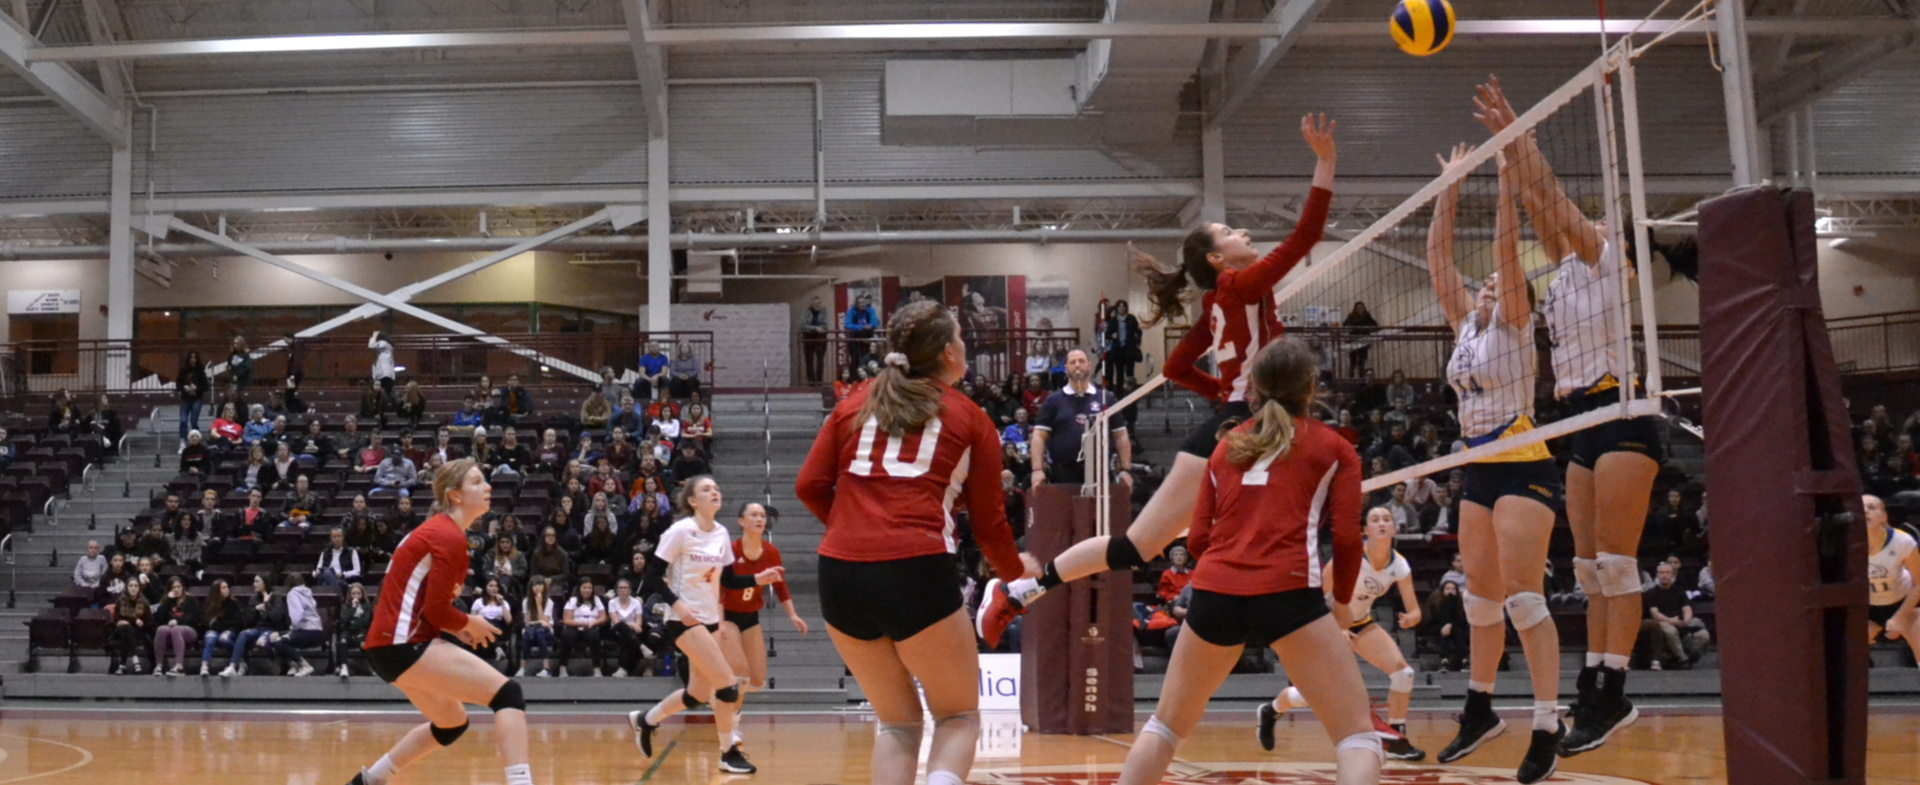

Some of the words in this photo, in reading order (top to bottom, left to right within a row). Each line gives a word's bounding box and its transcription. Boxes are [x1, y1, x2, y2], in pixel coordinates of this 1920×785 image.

[1209, 303, 1237, 364] 2
[848, 412, 943, 478] 10
[703, 566, 717, 583] 4
[742, 586, 755, 601] 8
[1084, 667, 1098, 712] Senoh
